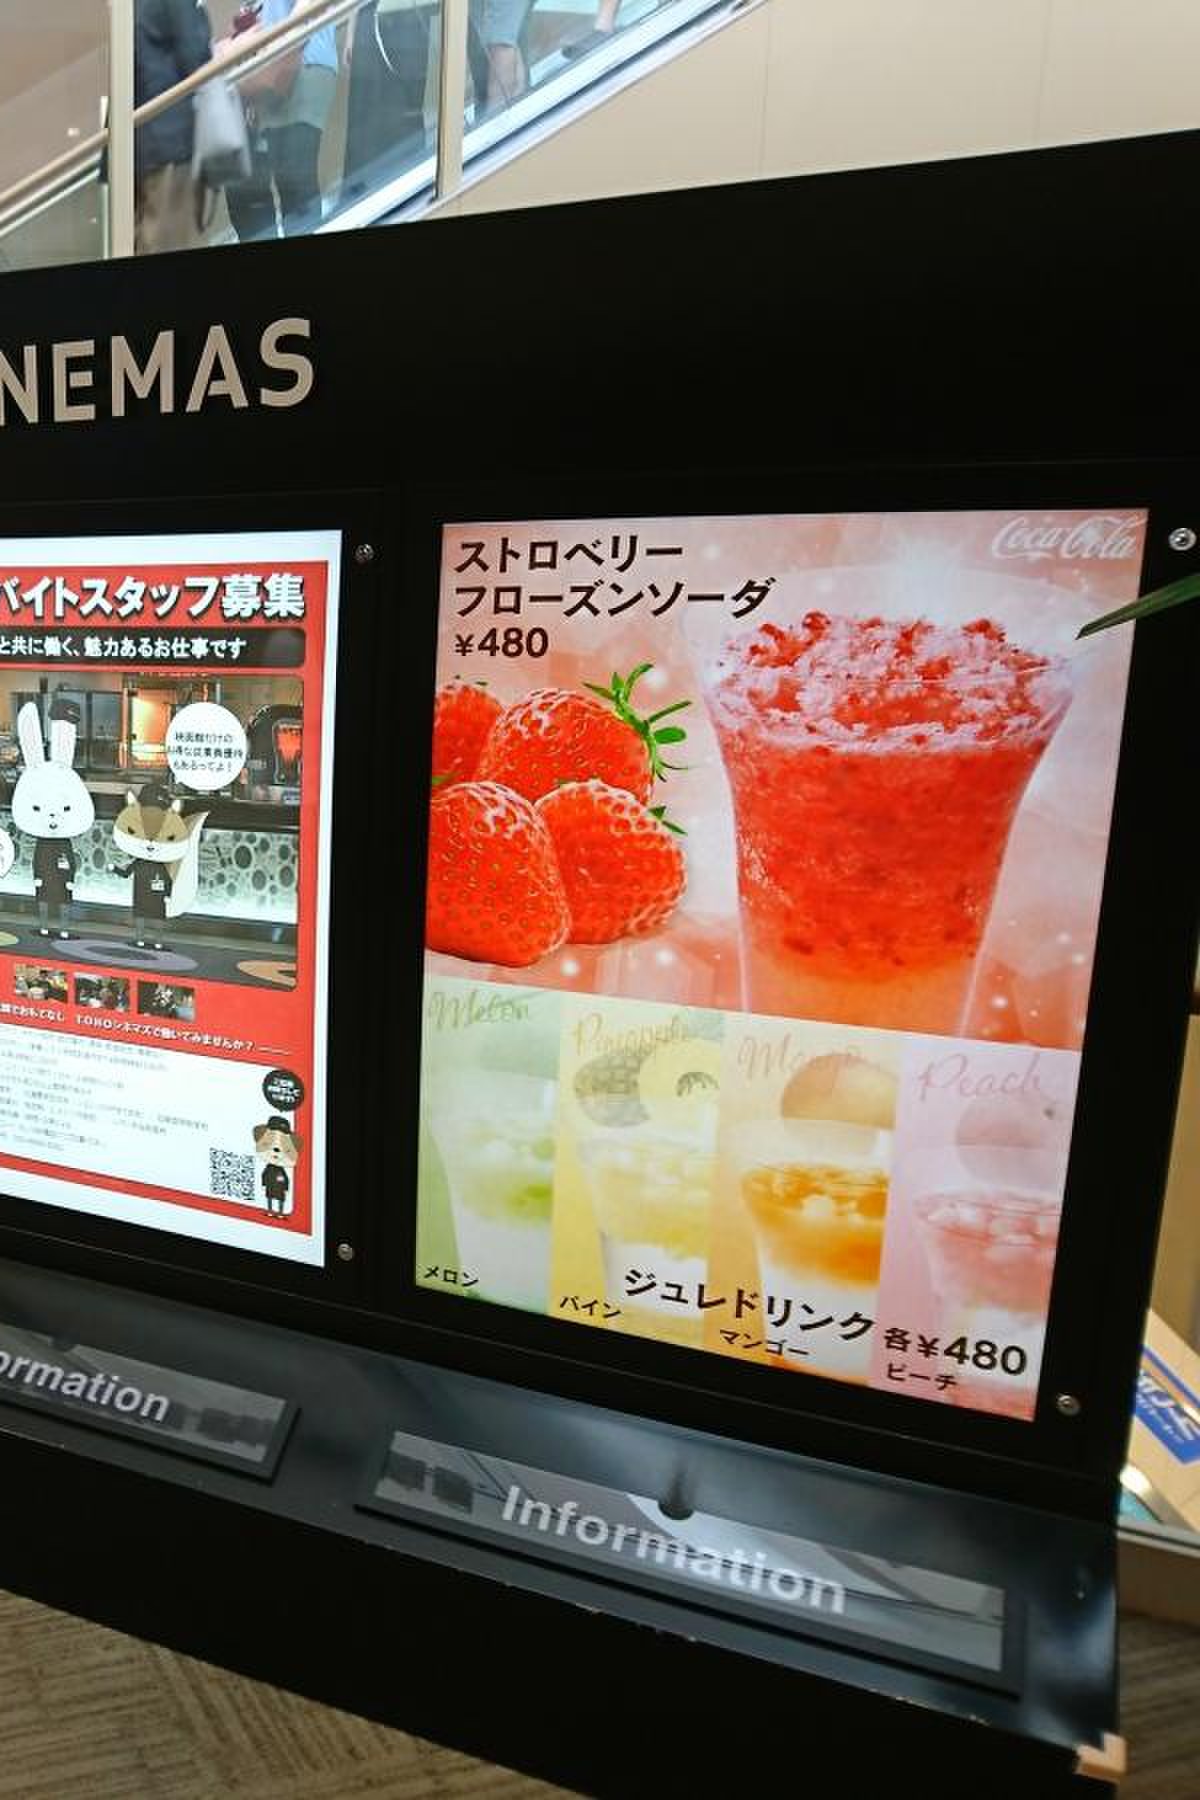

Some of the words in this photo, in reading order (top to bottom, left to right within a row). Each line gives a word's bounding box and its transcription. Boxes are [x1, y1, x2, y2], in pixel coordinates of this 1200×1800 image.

[453, 534, 684, 574] ストロベリー
[455, 576, 778, 620] フローズンソーダ
[455, 627, 549, 659] ¥480
[424, 1266, 479, 1287] メロン
[624, 1267, 876, 1341] ジュレドリンク
[718, 1328, 809, 1357] マンゴー
[501, 1484, 849, 1616] Information
